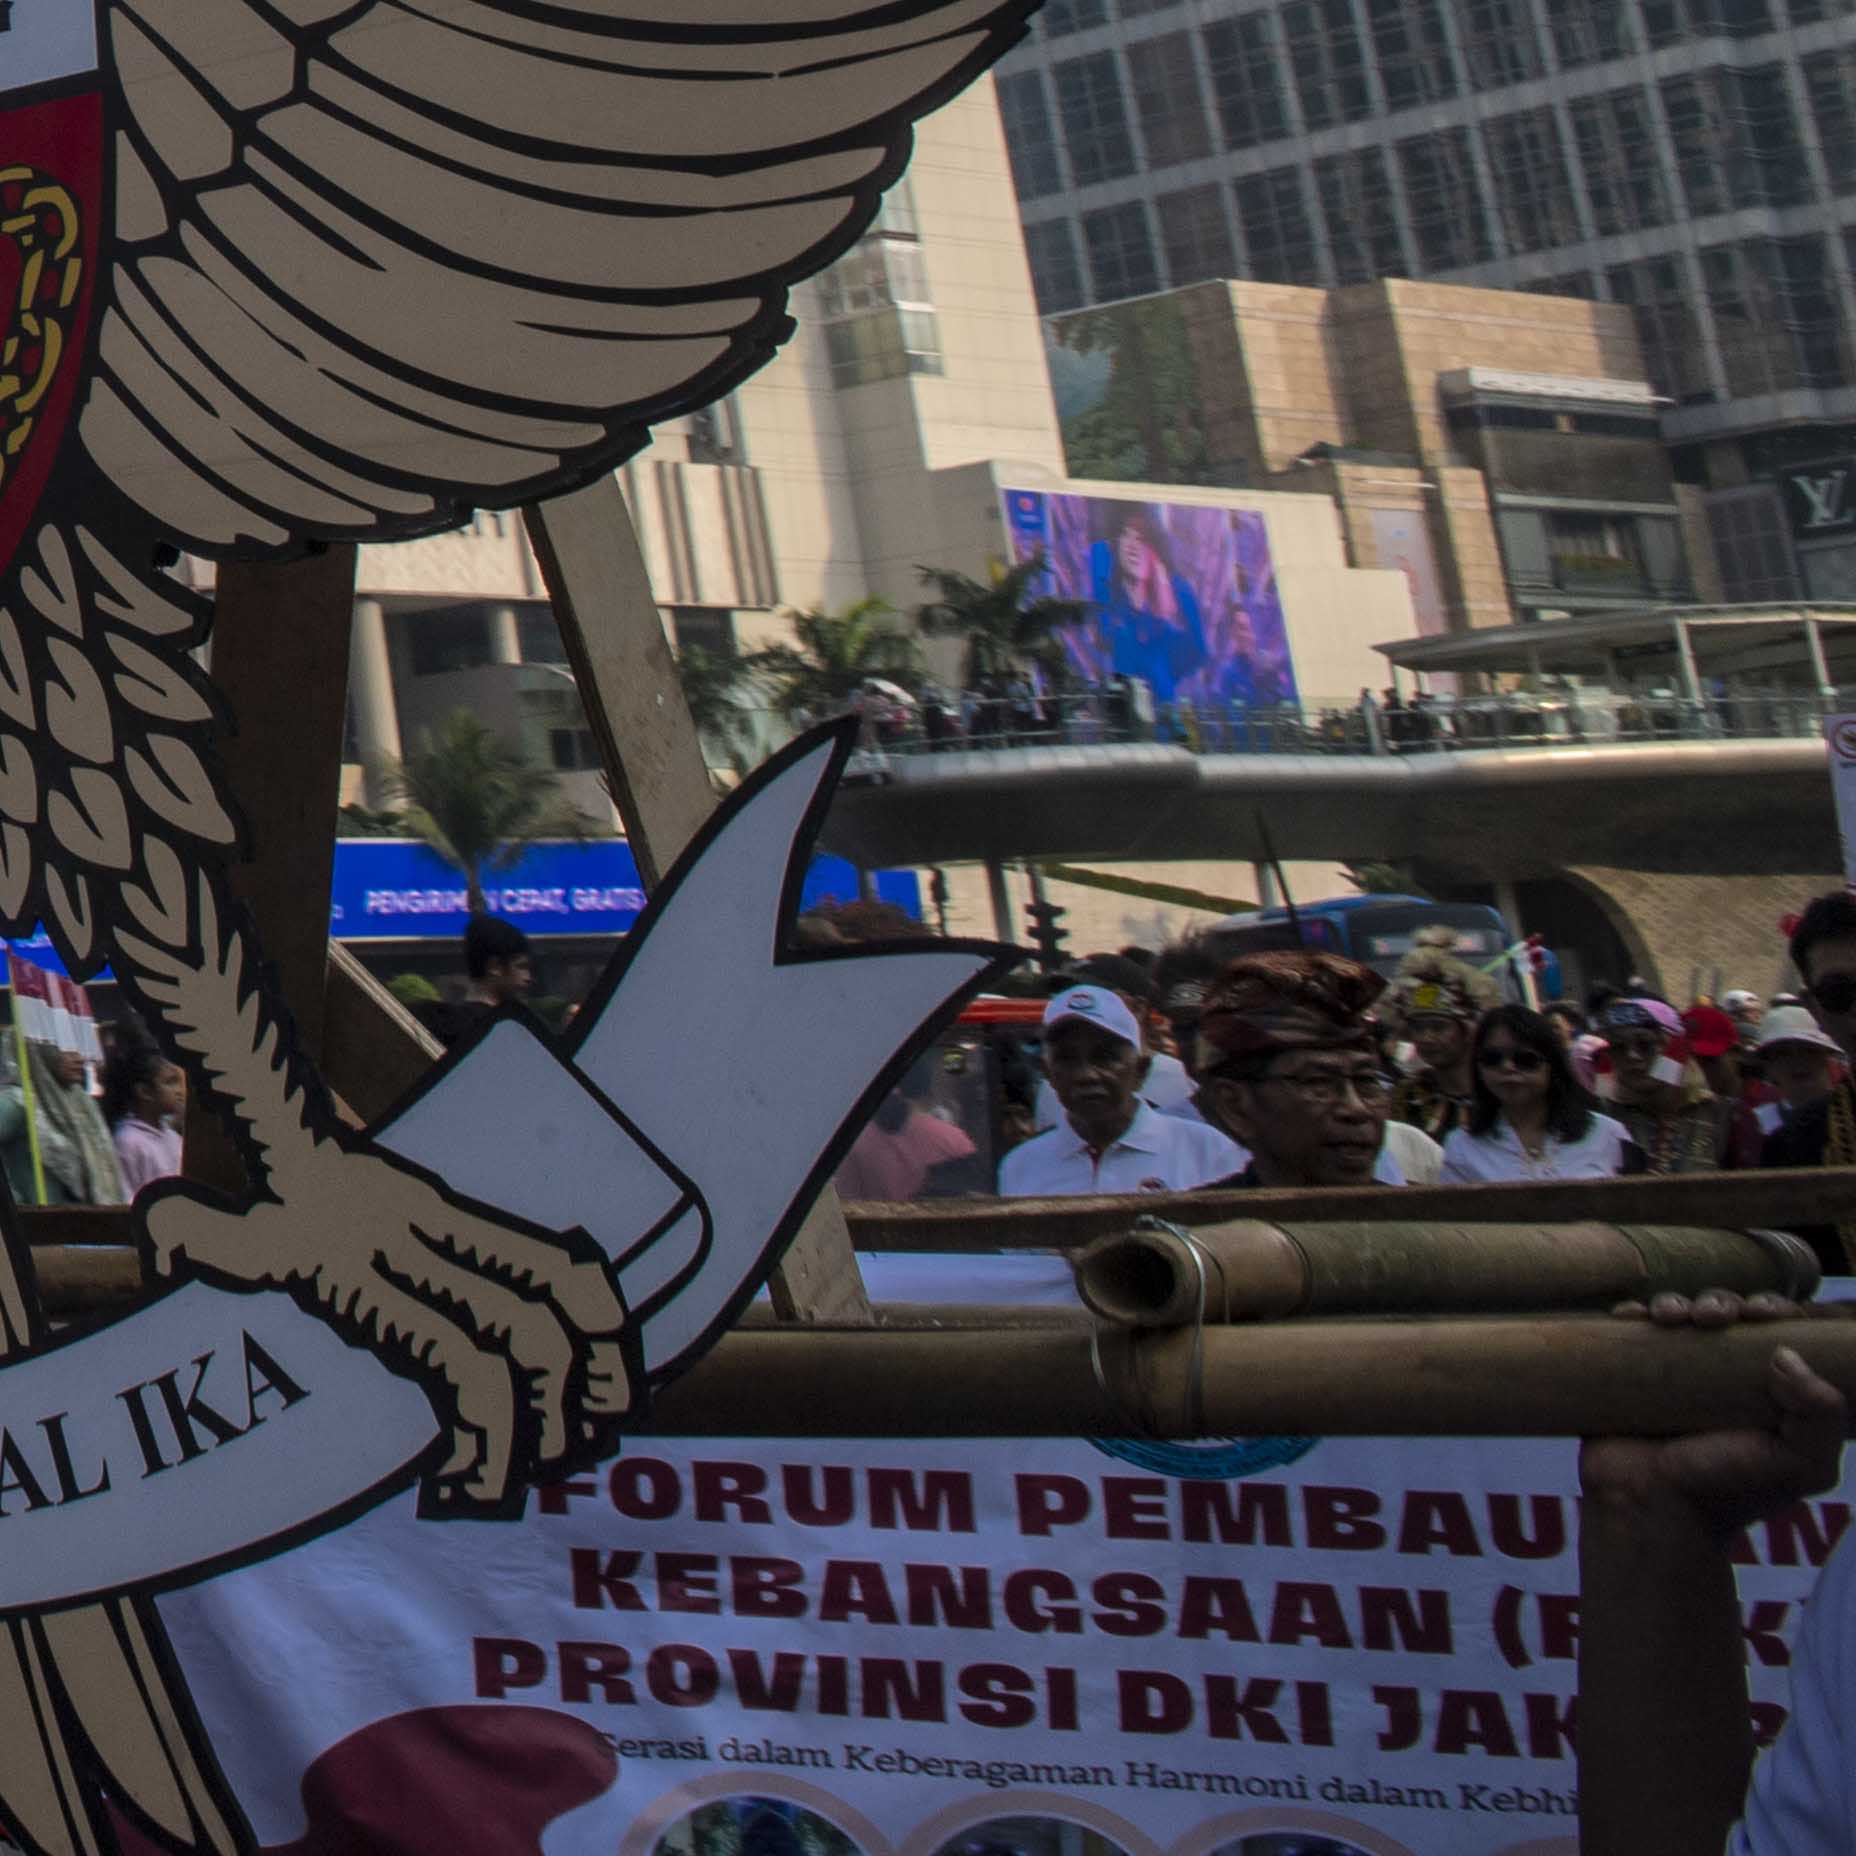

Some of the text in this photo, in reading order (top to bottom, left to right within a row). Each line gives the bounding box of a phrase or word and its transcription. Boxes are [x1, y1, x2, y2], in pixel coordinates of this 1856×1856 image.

[364, 888, 498, 915] PENGIRIMN
[114, 1328, 311, 1479] IKA
[571, 1548, 1452, 1655] KEBANGSAAN
[472, 1636, 1080, 1730] PROVINSI
[1118, 1670, 1334, 1748] DKI
[596, 1732, 709, 1762] Serasi
[720, 1736, 832, 1770] dalam
[844, 1745, 1116, 1789] Keberagaman
[1126, 1761, 1309, 1801] Harmoni
[1321, 1775, 1449, 1811] dalam
